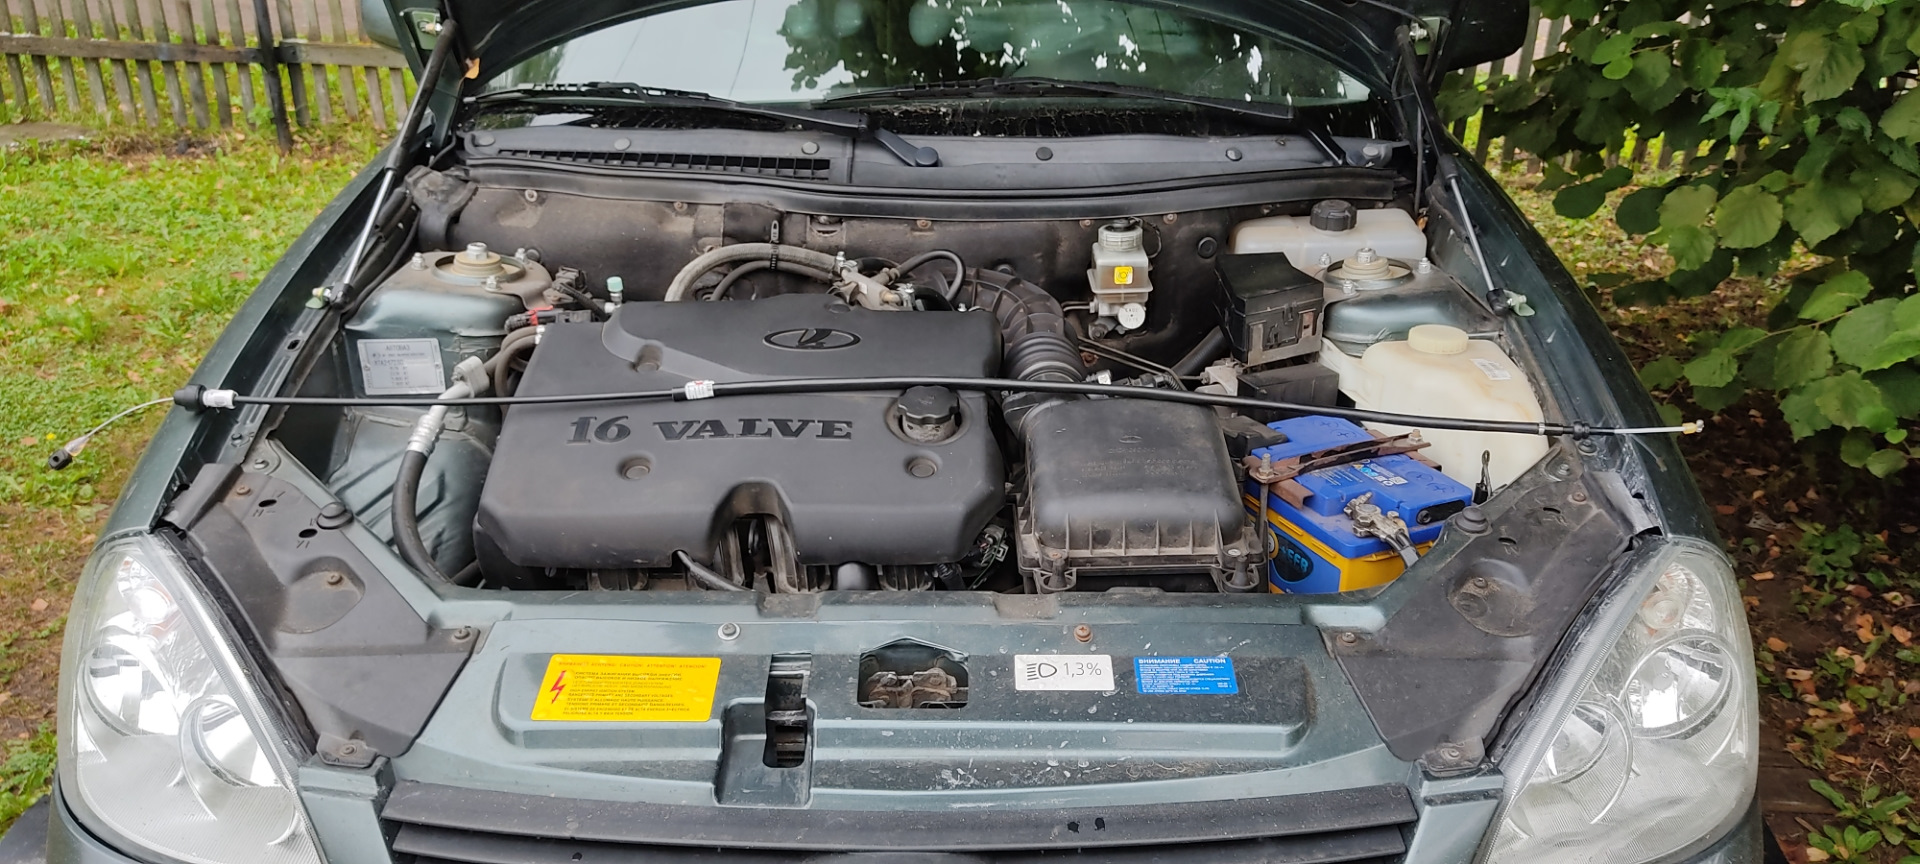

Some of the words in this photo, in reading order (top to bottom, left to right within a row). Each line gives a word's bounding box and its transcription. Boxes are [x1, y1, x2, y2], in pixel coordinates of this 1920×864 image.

[566, 415, 631, 445] 16
[653, 418, 853, 441] VALVE
[1063, 662, 1102, 678] 1,3%
